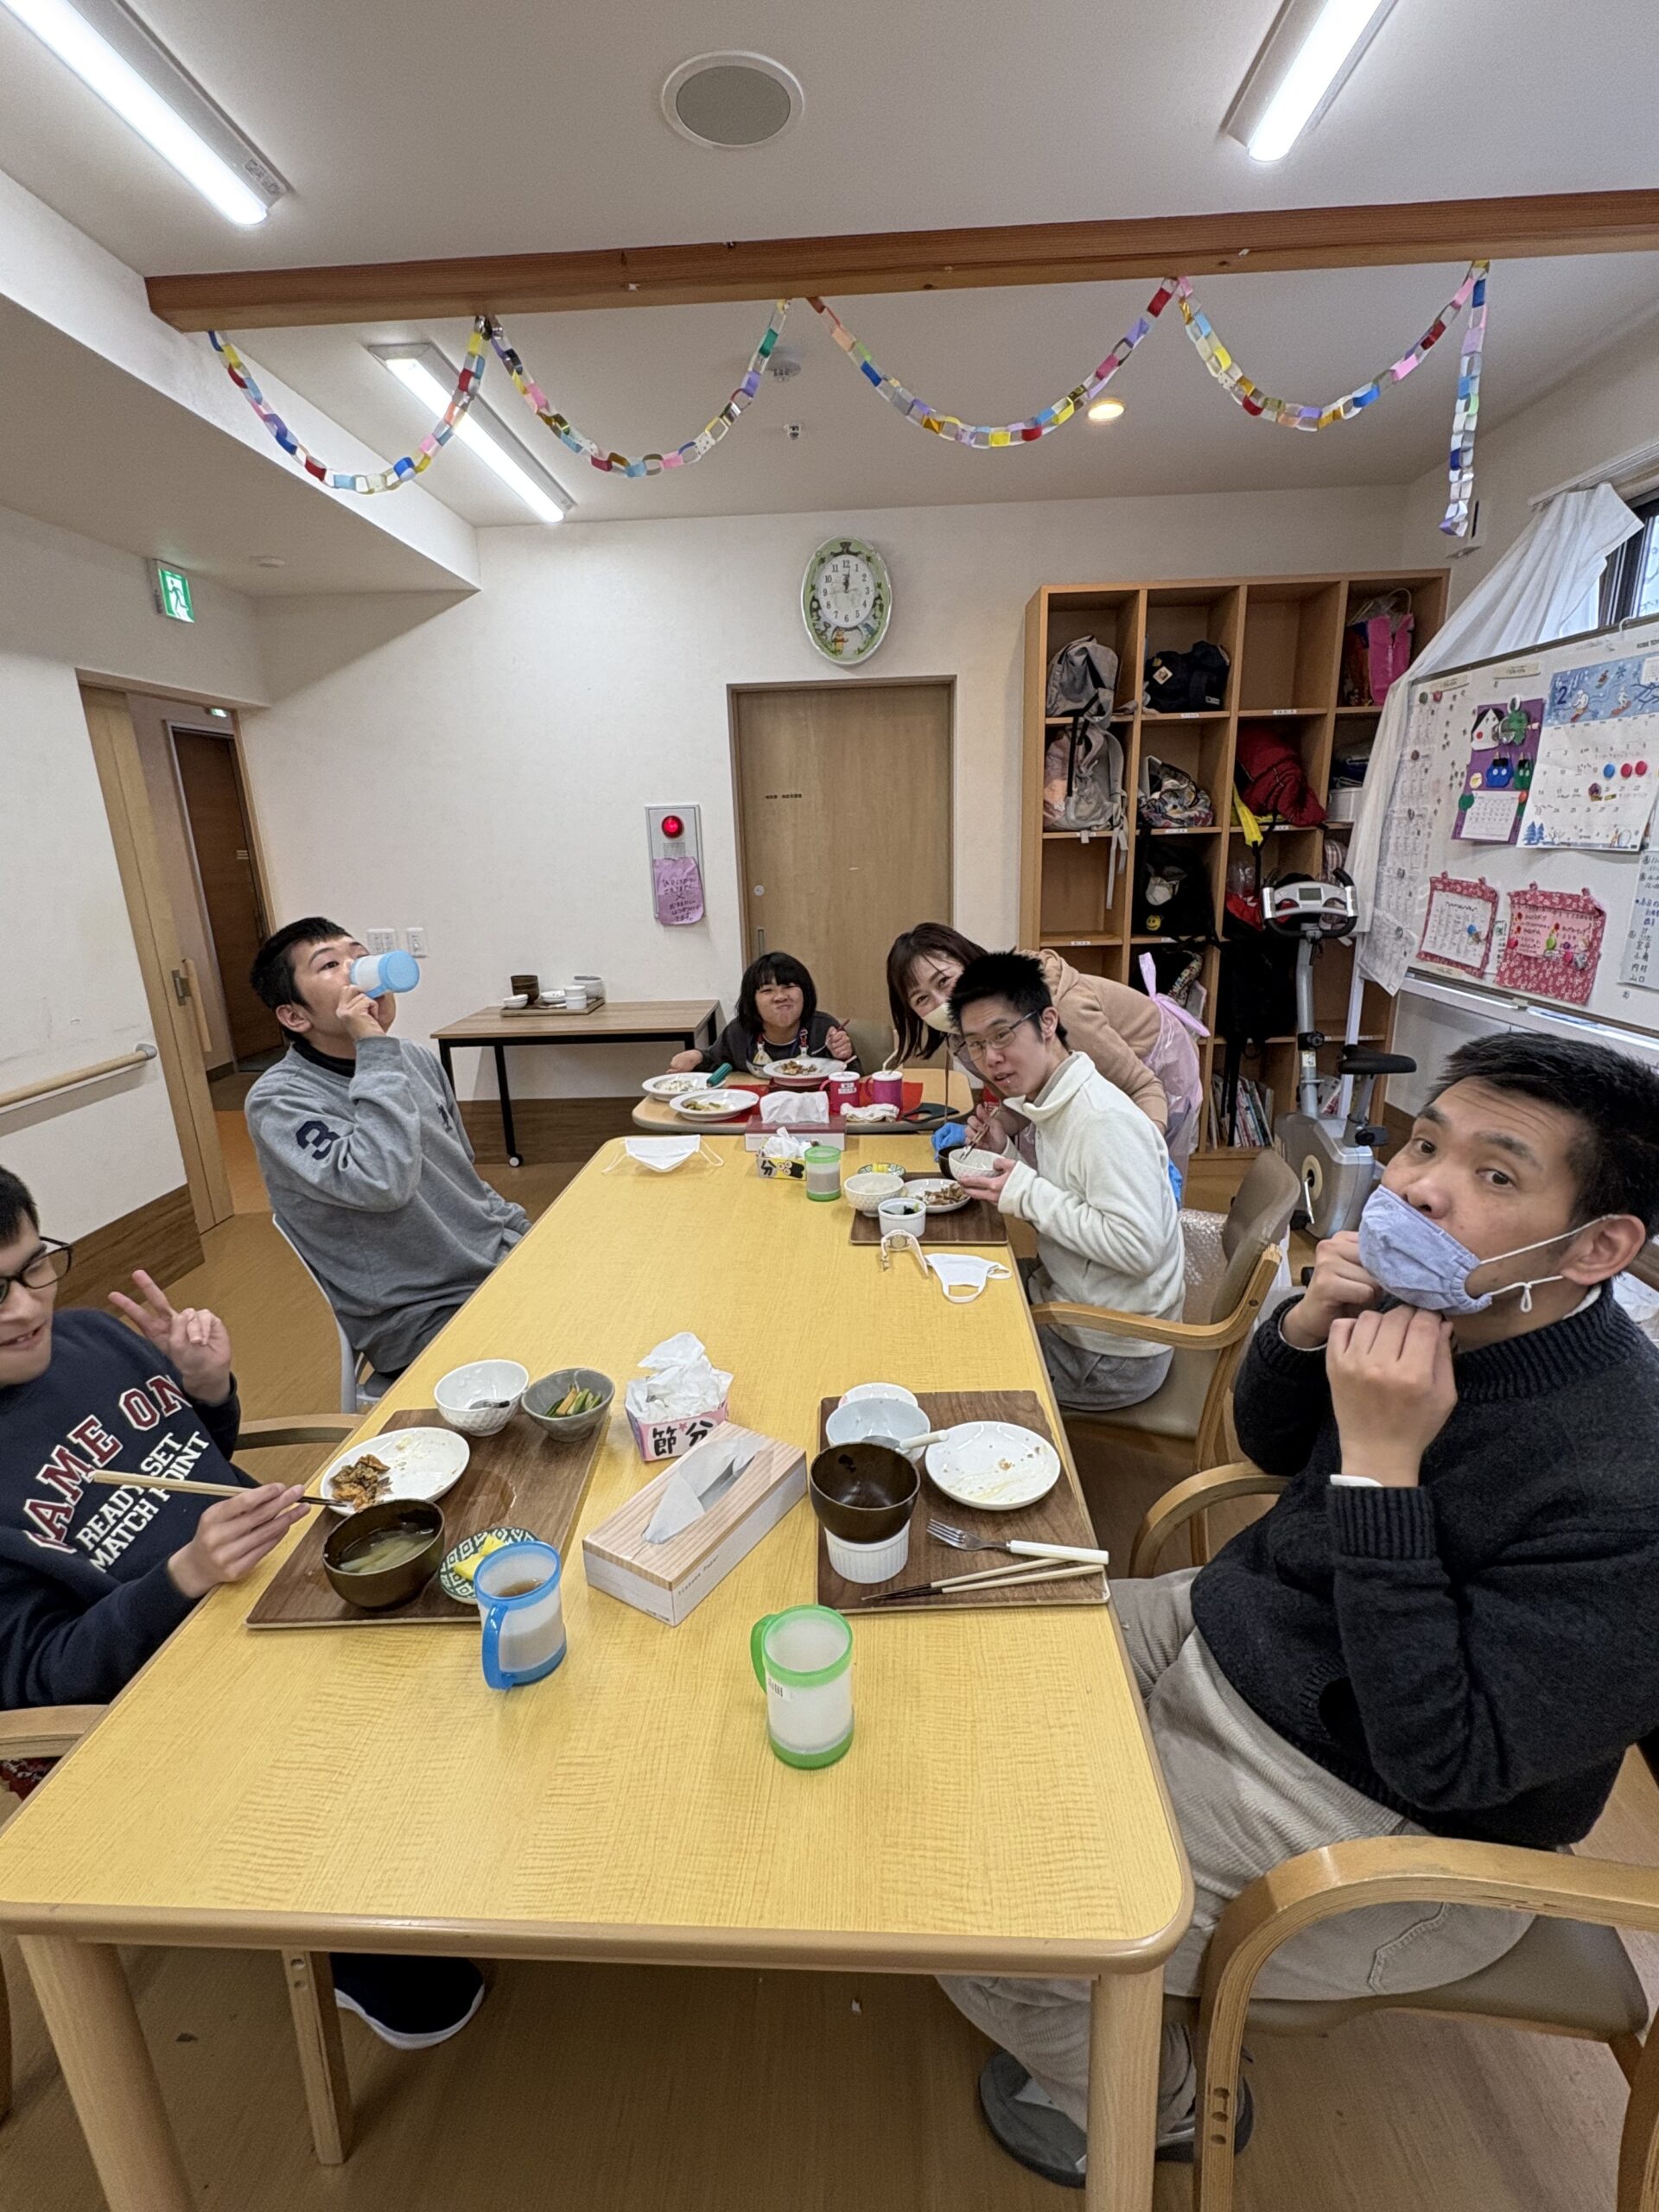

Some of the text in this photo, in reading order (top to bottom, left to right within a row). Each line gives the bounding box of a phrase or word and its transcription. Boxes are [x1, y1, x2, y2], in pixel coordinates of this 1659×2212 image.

[825, 575, 832, 583] 10
[855, 610, 860, 619] 5
[1557, 686, 1567, 705] 2
[140, 1432, 183, 1478] SET
[652, 1420, 714, 1457] 節分
[22, 1414, 124, 1554] AME
[89, 1497, 160, 1573] MATCH
